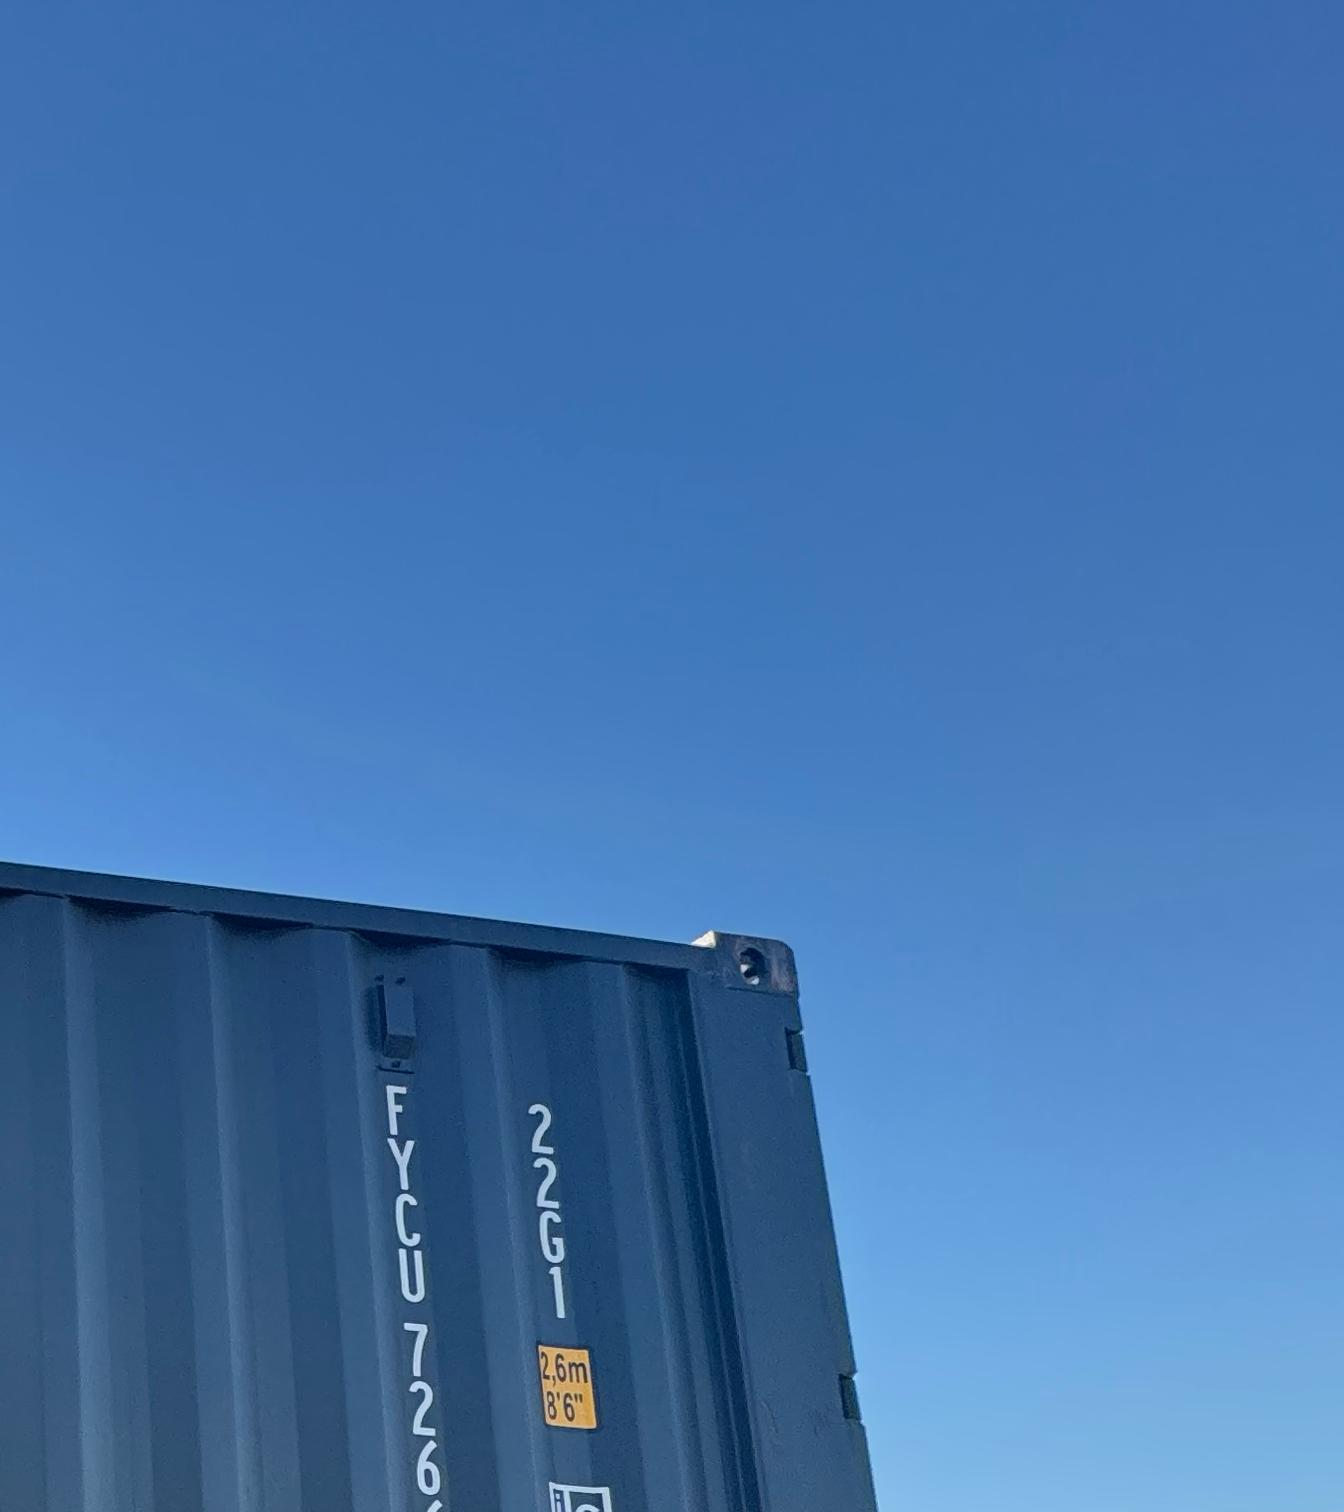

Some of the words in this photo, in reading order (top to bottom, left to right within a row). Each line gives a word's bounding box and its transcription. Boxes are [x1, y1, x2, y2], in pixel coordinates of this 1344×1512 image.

[386, 1084, 426, 1303] FYCU
[527, 1103, 566, 1319] 22G1
[540, 1350, 589, 1387] 2,6m
[545, 1390, 584, 1422] 8'6"
